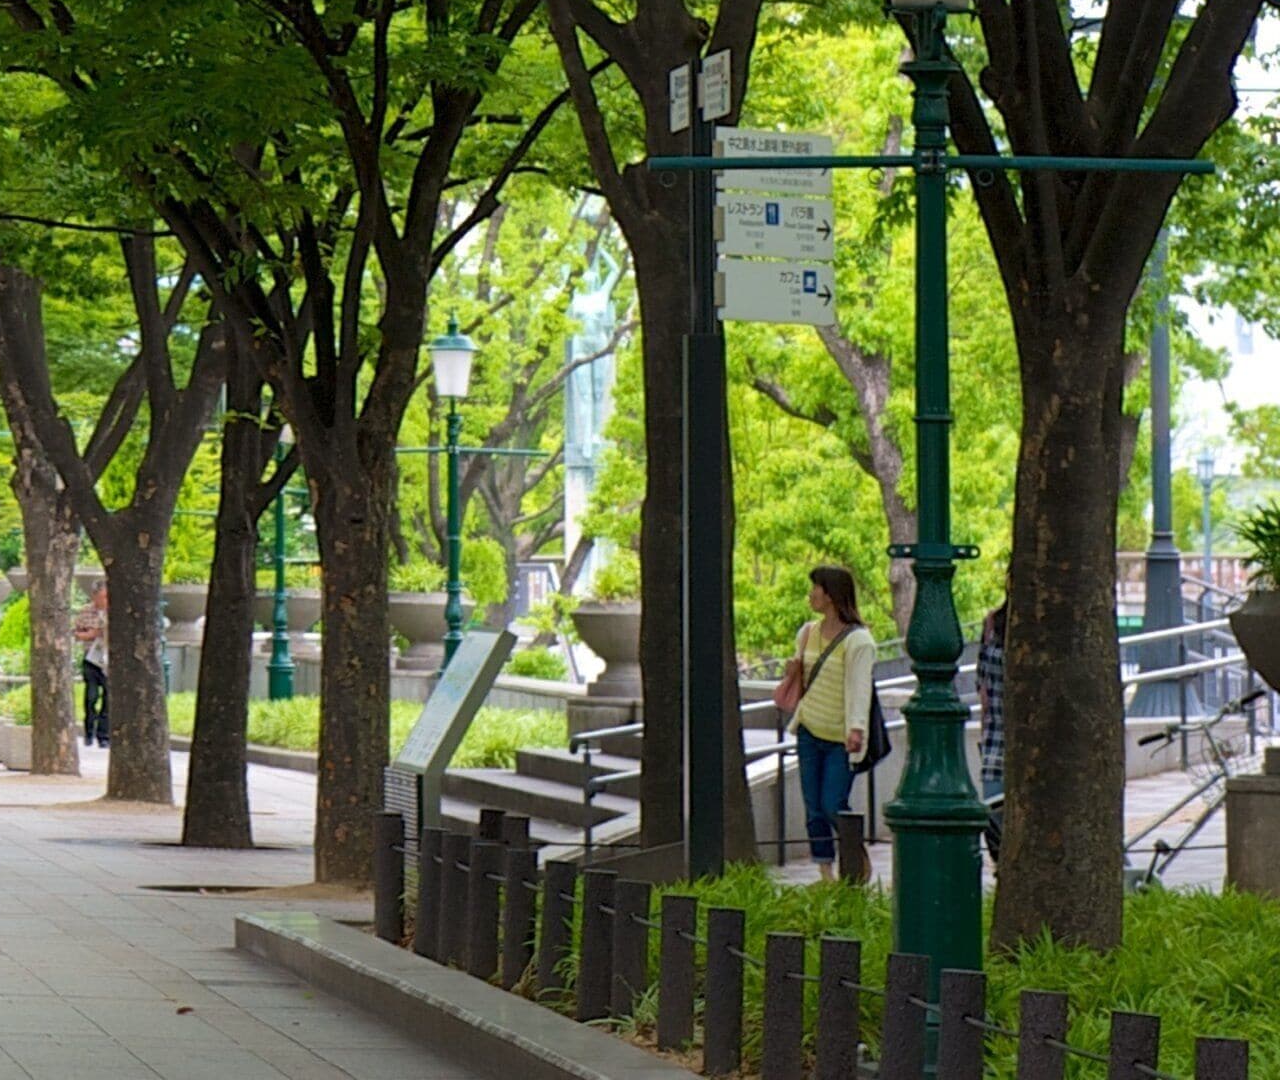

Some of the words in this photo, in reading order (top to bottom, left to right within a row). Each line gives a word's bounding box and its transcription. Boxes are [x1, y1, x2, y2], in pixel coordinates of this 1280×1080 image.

[727, 202, 764, 217] レストラン
[779, 271, 801, 284] カフェ
